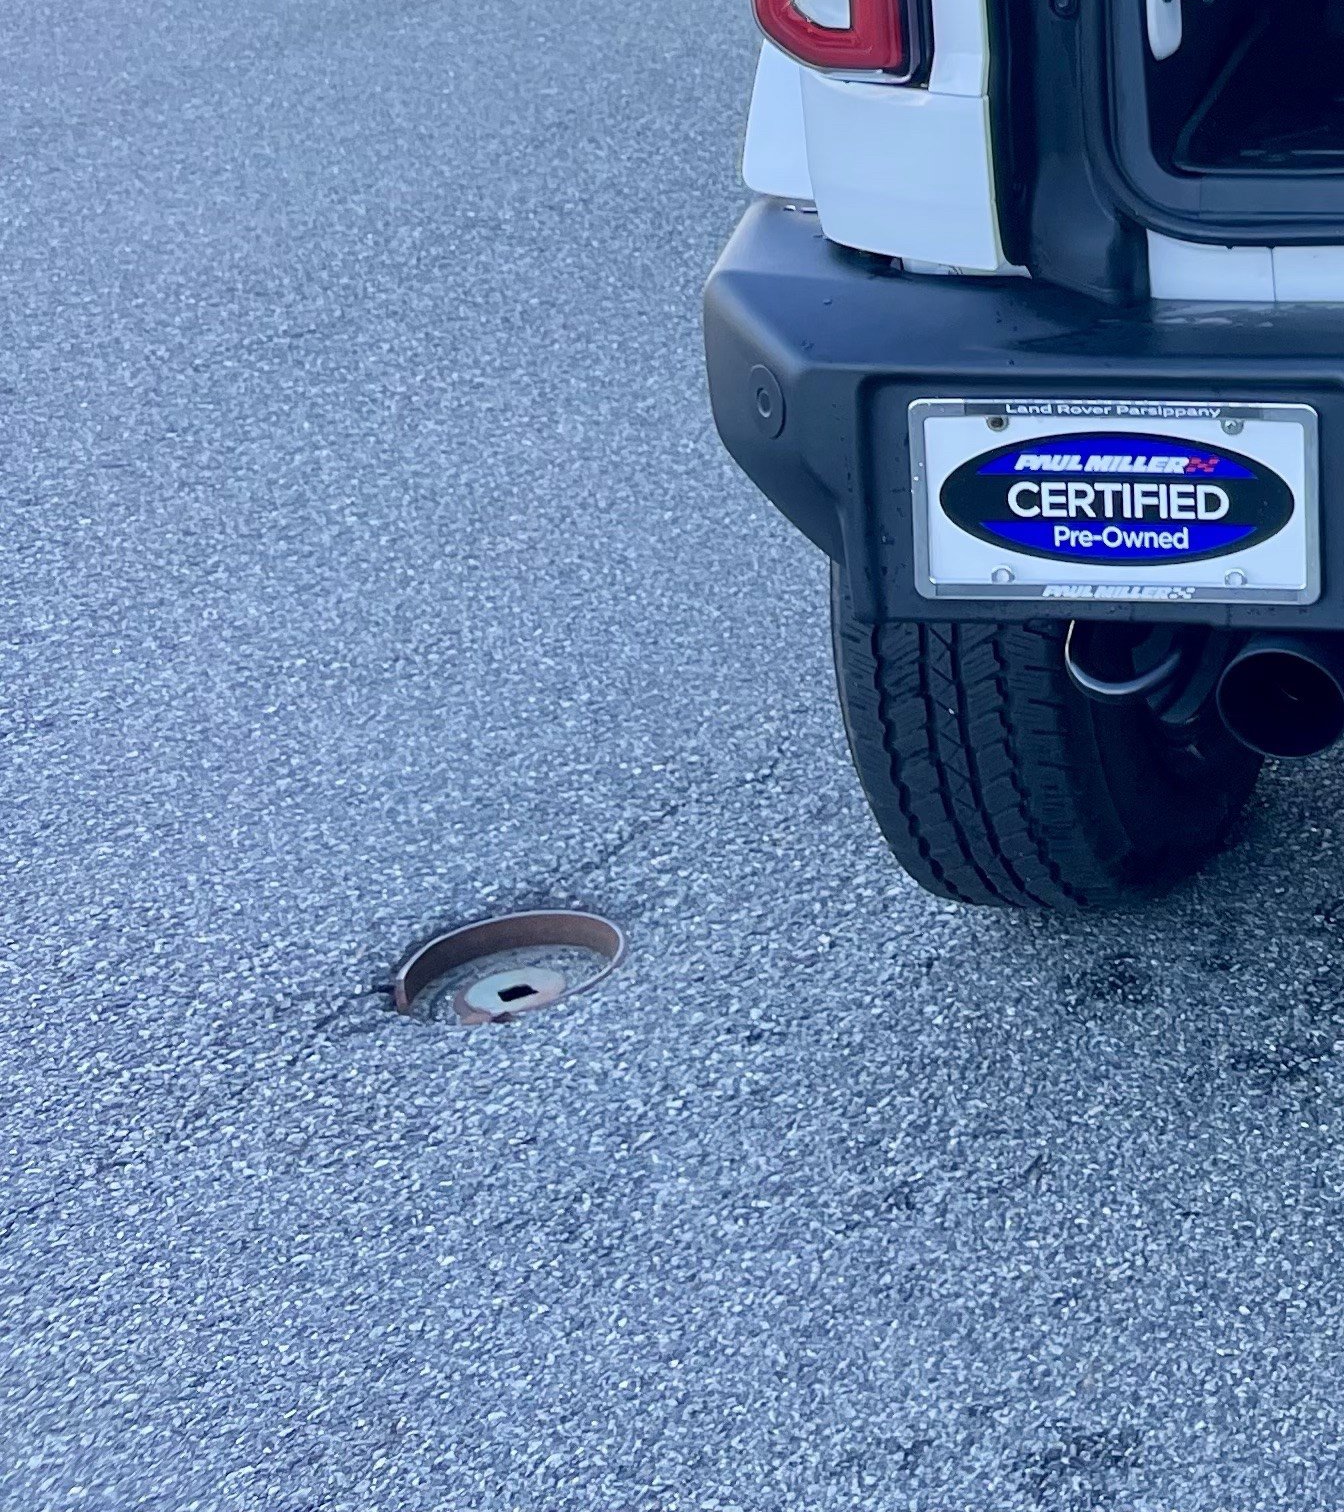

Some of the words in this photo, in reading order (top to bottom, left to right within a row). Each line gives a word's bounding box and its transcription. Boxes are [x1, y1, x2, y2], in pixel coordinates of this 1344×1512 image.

[1005, 403, 1053, 415] Land
[1057, 404, 1112, 415] Rover
[1116, 405, 1221, 418] Parsippany
[1013, 454, 1083, 472] PAUL
[1083, 454, 1190, 474] MILLER
[1007, 481, 1230, 521] CERTIFIED
[1053, 525, 1189, 550] Pre-Owned
[1042, 585, 1094, 598] PAUL
